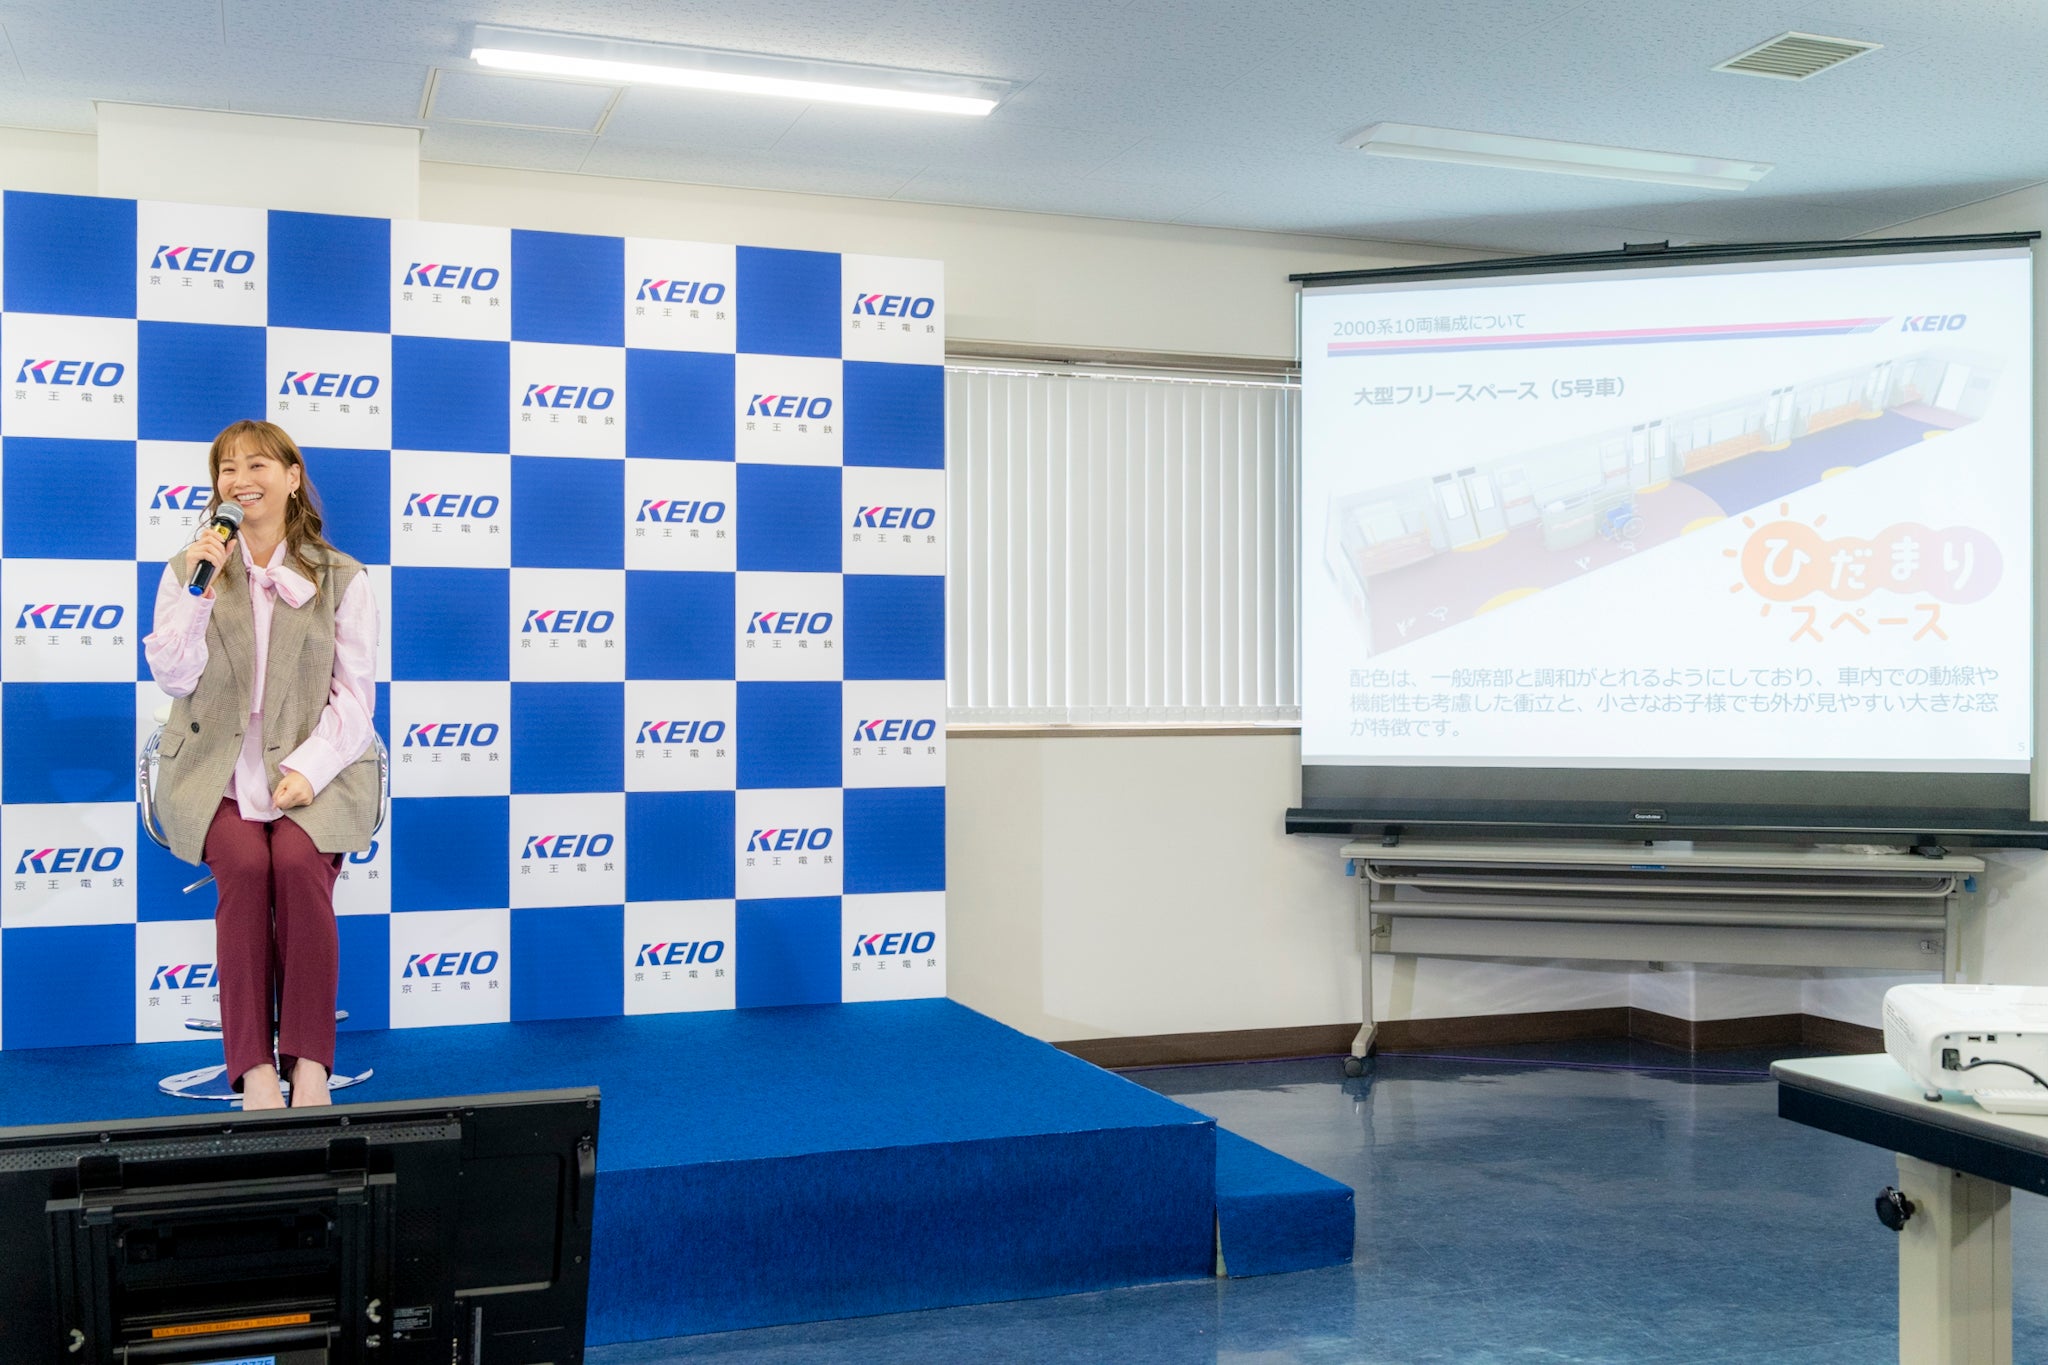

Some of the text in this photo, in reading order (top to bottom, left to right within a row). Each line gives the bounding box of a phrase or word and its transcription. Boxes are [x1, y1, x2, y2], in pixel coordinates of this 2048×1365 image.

[150, 245, 255, 274] KEIO
[151, 275, 255, 290] 京王電鉄
[403, 263, 499, 290] KEIO
[403, 291, 499, 307] 京王電鉄
[636, 279, 725, 304] KEIO
[637, 306, 725, 320] 京王電鉄
[852, 293, 934, 318] KEIO
[853, 320, 934, 333] 京王電鉄
[1333, 313, 1526, 336] 2000系10両編成について
[1902, 314, 1966, 332] KEIO
[15, 359, 125, 386] KEIO
[279, 371, 379, 398] KEIO
[16, 390, 124, 403] 京王電鉄
[279, 400, 379, 415] 京王電鉄
[522, 384, 614, 409] KEIO
[746, 394, 832, 418] KEIO
[522, 412, 614, 425] 京王電鉄
[747, 421, 832, 433] 京王電鉄
[150, 485, 213, 510] KE
[402, 493, 499, 518] KEIO
[149, 516, 192, 526] 京王
[636, 499, 725, 523] KEIO
[853, 506, 935, 528] KEIO
[403, 522, 499, 533] 京王電鉄
[636, 527, 725, 538] 京王電鉄
[853, 533, 935, 543] 京王電鉄
[1763, 536, 1975, 590] ひだまり
[15, 603, 124, 629] KEIO
[521, 609, 614, 632] KEIO
[746, 611, 833, 634] KEIO
[1790, 603, 1948, 642] スペース
[15, 635, 123, 645] 京王電鉄
[522, 638, 614, 648] 京王電鉄
[747, 639, 832, 648] 京王電鉄
[402, 723, 499, 747] KEIO
[635, 720, 725, 743] KEIO
[853, 719, 936, 741] KEIO
[1350, 718, 1461, 738] が特徴です。
[403, 752, 498, 763] 京王電鉄
[636, 748, 725, 758] 京王電鉄
[853, 747, 936, 756] 京王電鉄
[521, 833, 614, 859] KEIO
[746, 827, 833, 852] KEIO
[14, 846, 125, 874] KEIO
[521, 863, 614, 874] 京王電鉄
[747, 856, 832, 866] 京王電鉄
[15, 878, 124, 890] 京王電鉄
[634, 940, 725, 966] KEIO
[851, 931, 936, 956] KEIO
[402, 950, 499, 978] KEIO
[635, 969, 724, 981] 京王電鉄
[853, 959, 935, 971] 京王電鉄
[149, 964, 218, 990] KEI
[402, 979, 498, 993] 京王電鉄
[149, 994, 219, 1006] 京王電
